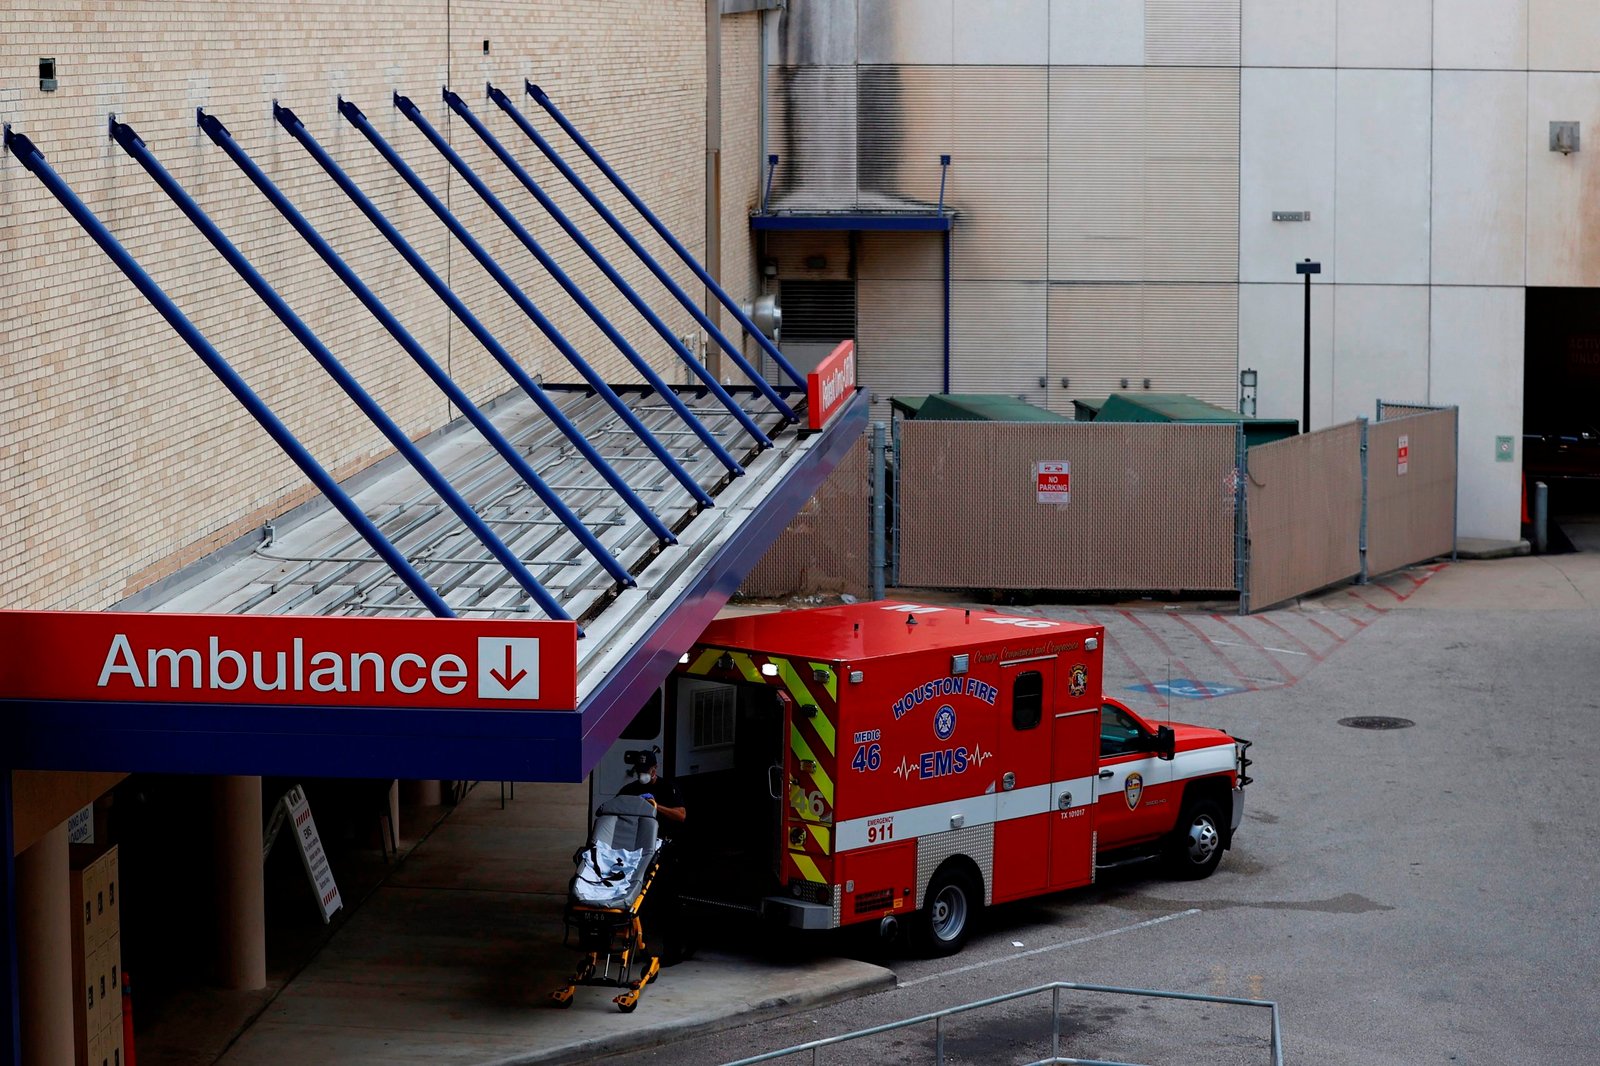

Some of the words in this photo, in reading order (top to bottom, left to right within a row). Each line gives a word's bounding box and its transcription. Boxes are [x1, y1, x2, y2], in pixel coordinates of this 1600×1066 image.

[1048, 476, 1059, 484] NO
[1039, 484, 1068, 492] PARKING
[879, 604, 948, 614] M
[97, 633, 469, 694] Ambulance
[892, 676, 964, 720] HOUSTON
[966, 677, 998, 706] FIRE
[854, 729, 881, 744] MEDIC
[852, 743, 881, 772] 46
[919, 746, 969, 780] EMS
[867, 816, 894, 826] EMERGENCY
[1061, 811, 1068, 819] TX
[868, 823, 893, 843] 911
